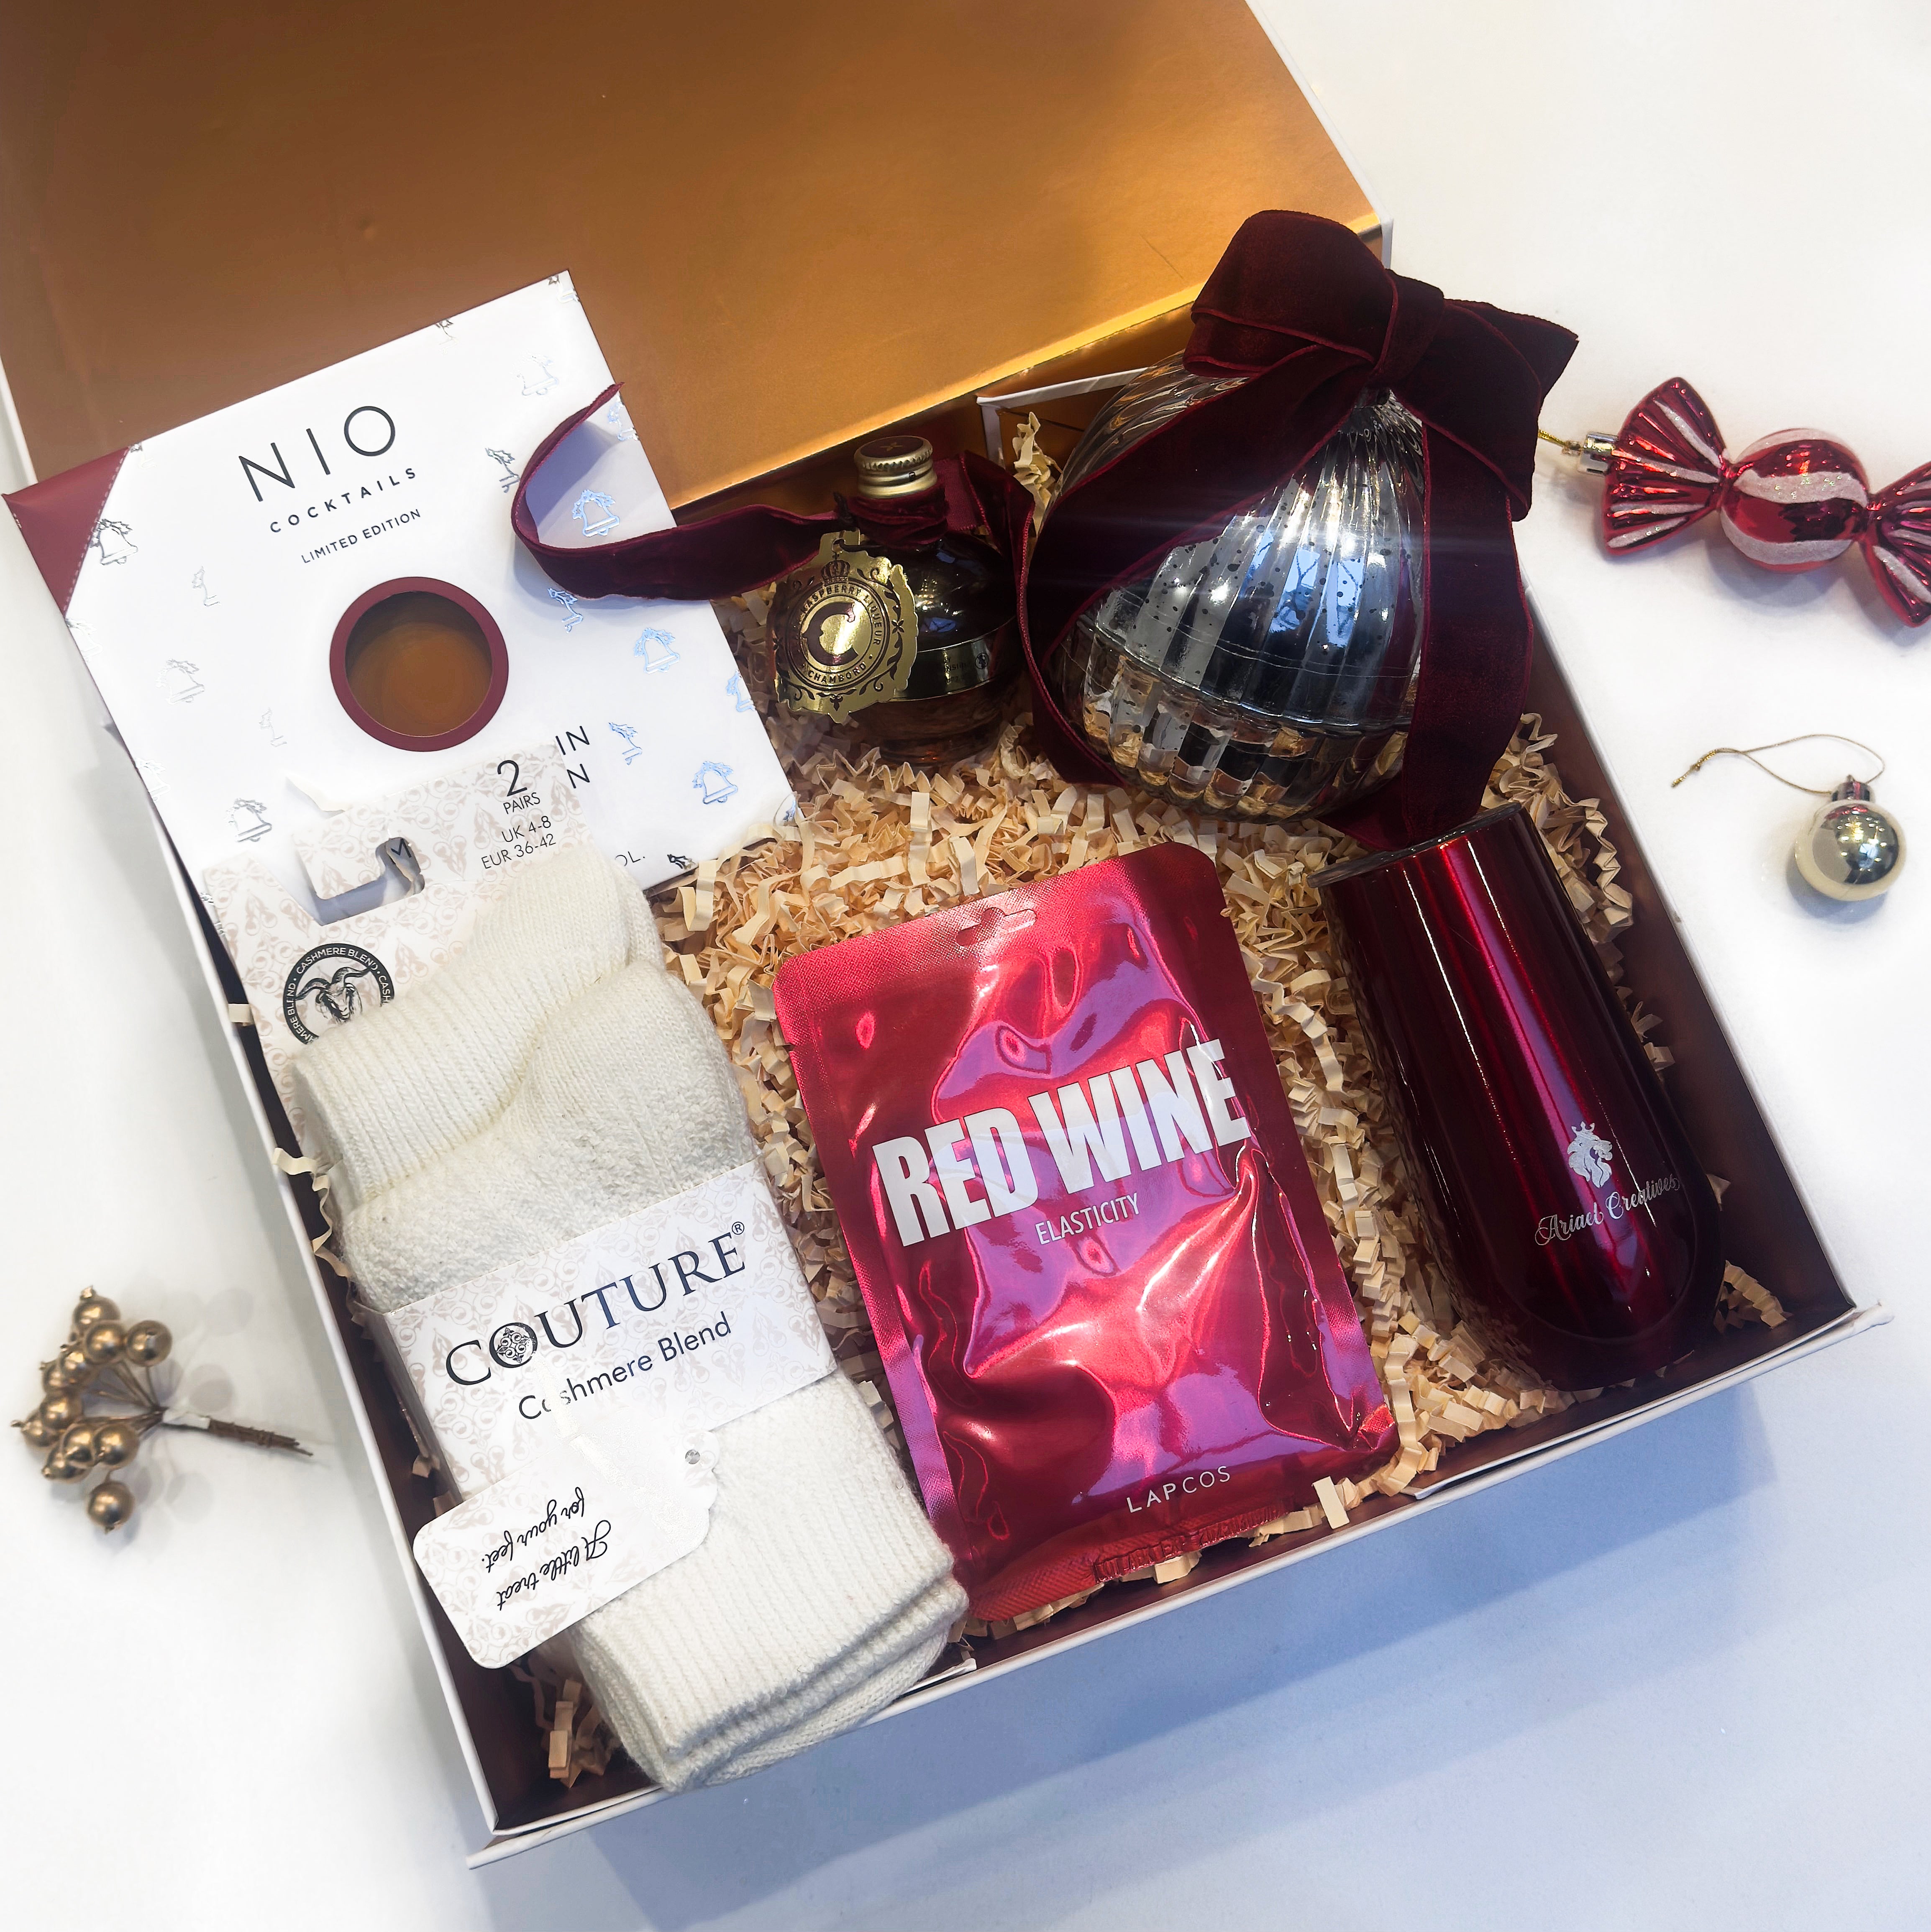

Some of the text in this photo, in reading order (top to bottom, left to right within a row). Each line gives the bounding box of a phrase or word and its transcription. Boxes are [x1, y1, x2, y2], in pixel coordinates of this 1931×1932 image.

[239, 406, 395, 502] NIO
[271, 469, 415, 532] COCKTAILS
[302, 509, 420, 563] LIMITED EDITION
[808, 661, 866, 683] CHAMBORD
[497, 760, 527, 796] 2
[503, 792, 540, 814] PAIRS
[481, 834, 556, 869] EUR 36-42
[502, 816, 551, 842] UK 4-8
[296, 947, 378, 974] CASHMERE BLEND
[872, 1039, 1251, 1247] RED WINE
[1035, 1193, 1140, 1245] ELASTICITY
[1606, 1174, 1680, 1219] Creatives
[658, 1311, 731, 1361] Blend
[1126, 1466, 1230, 1513] LAPCOS
[482, 1486, 584, 1573] for your feet.
[497, 1520, 611, 1611] A little treat
